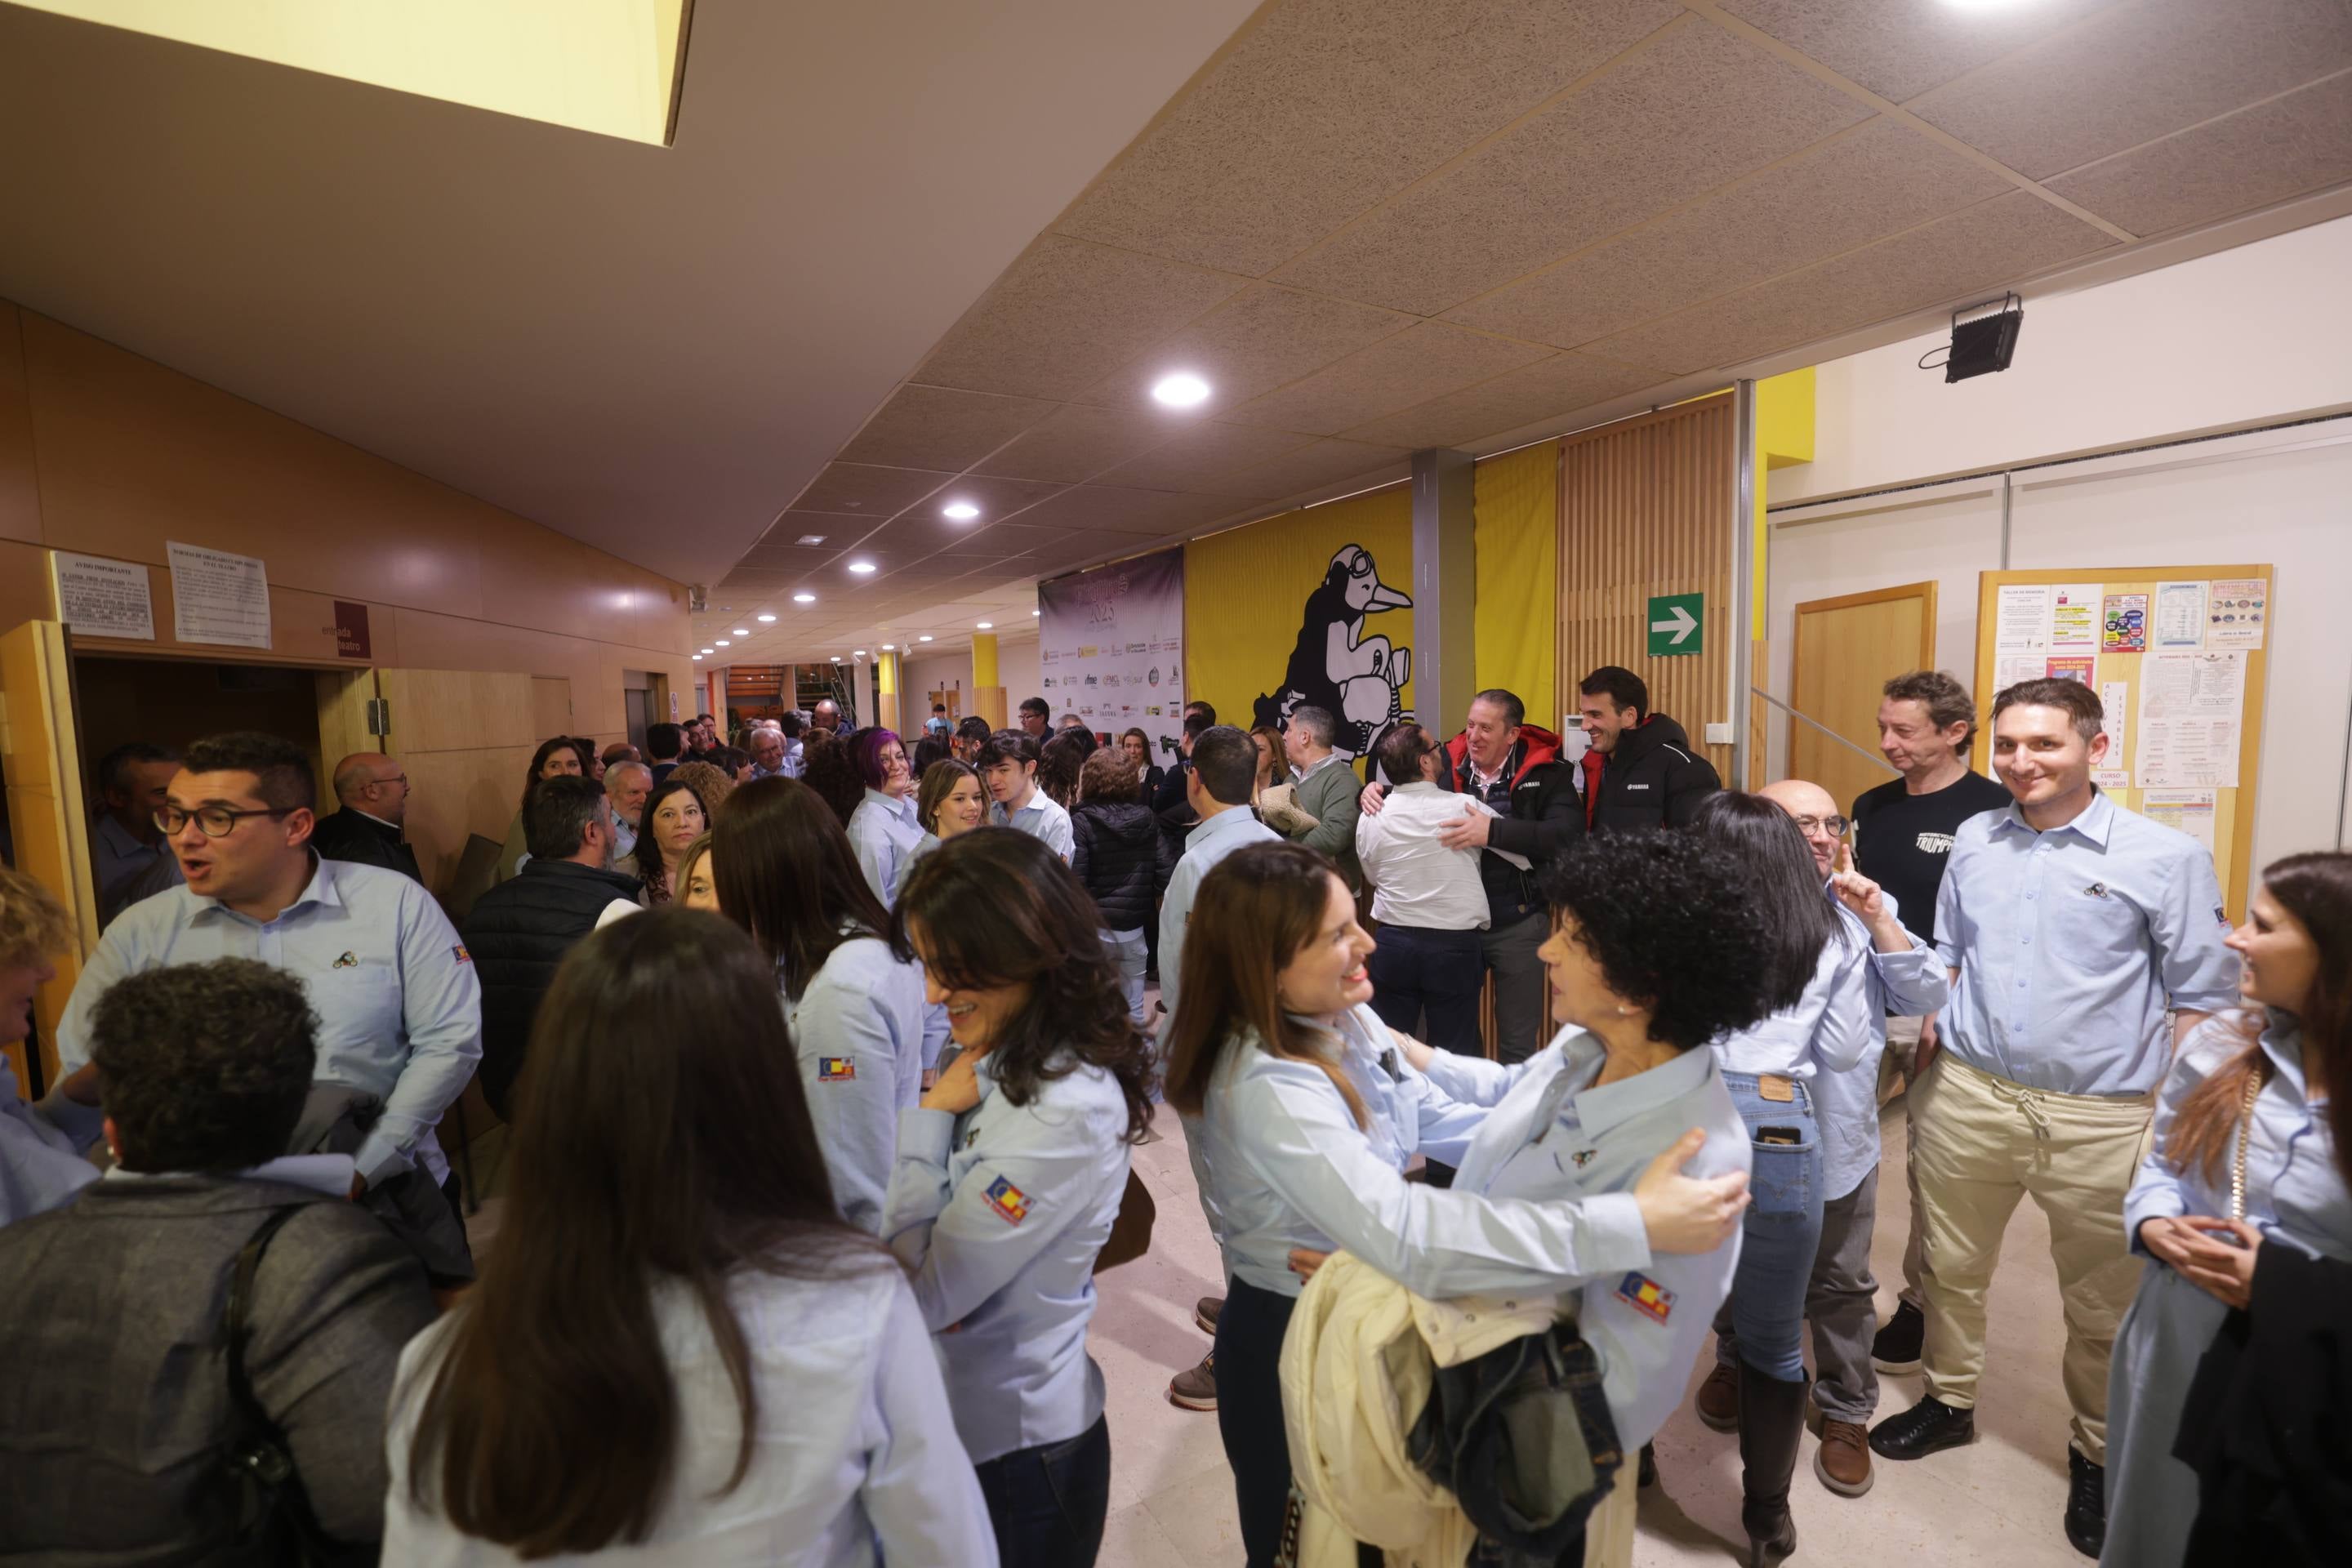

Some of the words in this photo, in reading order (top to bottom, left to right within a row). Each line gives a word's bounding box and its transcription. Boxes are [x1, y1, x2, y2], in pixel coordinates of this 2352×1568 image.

[74, 561, 93, 570] AVISO
[94, 564, 131, 575] IMPORTANTE
[322, 626, 351, 638] entrada
[338, 639, 360, 652] teatro
[1916, 836, 1953, 853] TRIUMPH
